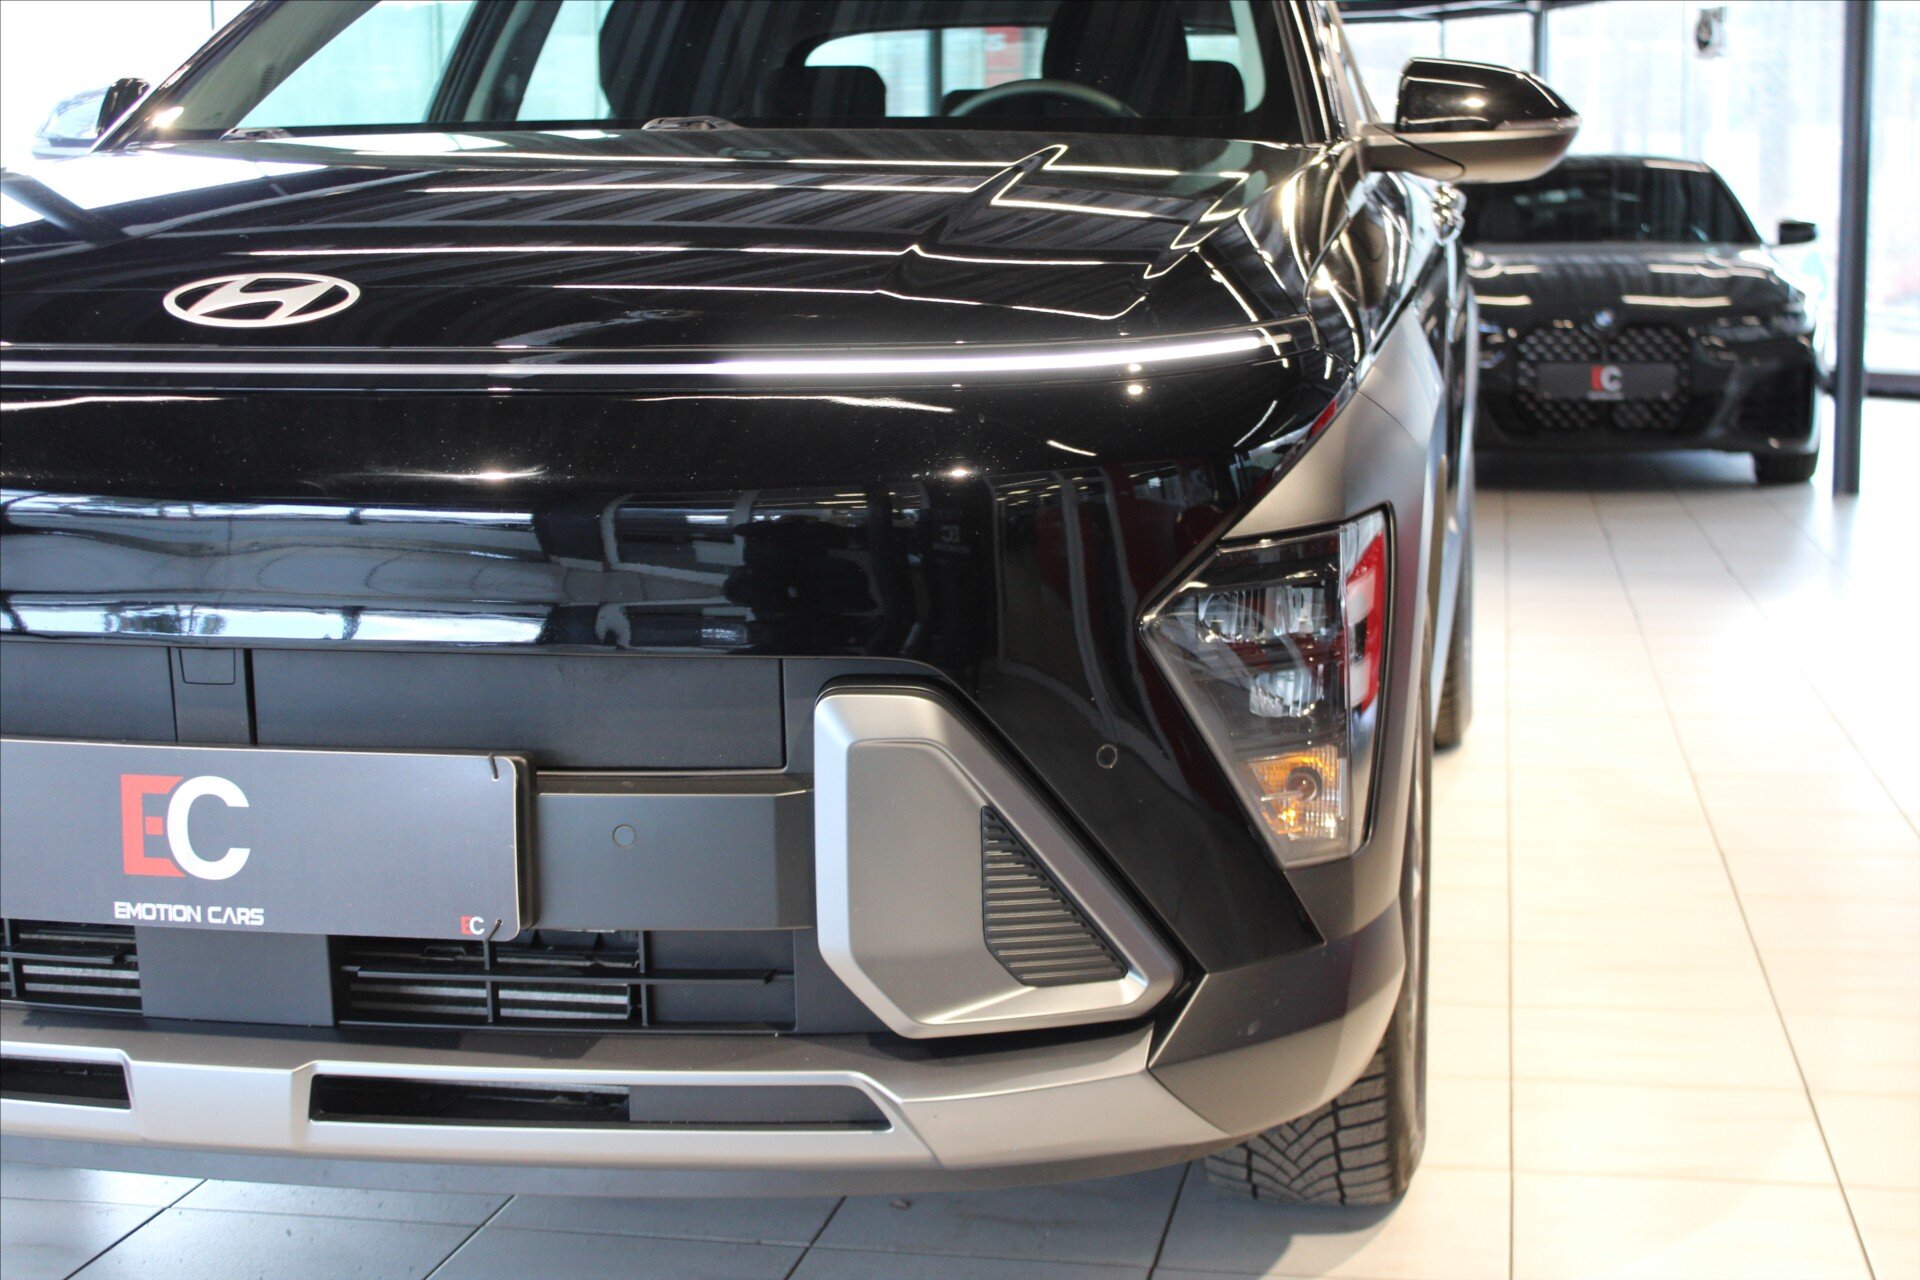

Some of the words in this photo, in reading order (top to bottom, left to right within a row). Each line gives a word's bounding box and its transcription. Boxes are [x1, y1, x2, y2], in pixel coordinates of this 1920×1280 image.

[120, 773, 251, 881] EC
[113, 901, 202, 923] EMOTION
[207, 906, 265, 926] CARS
[460, 915, 486, 936] EC
